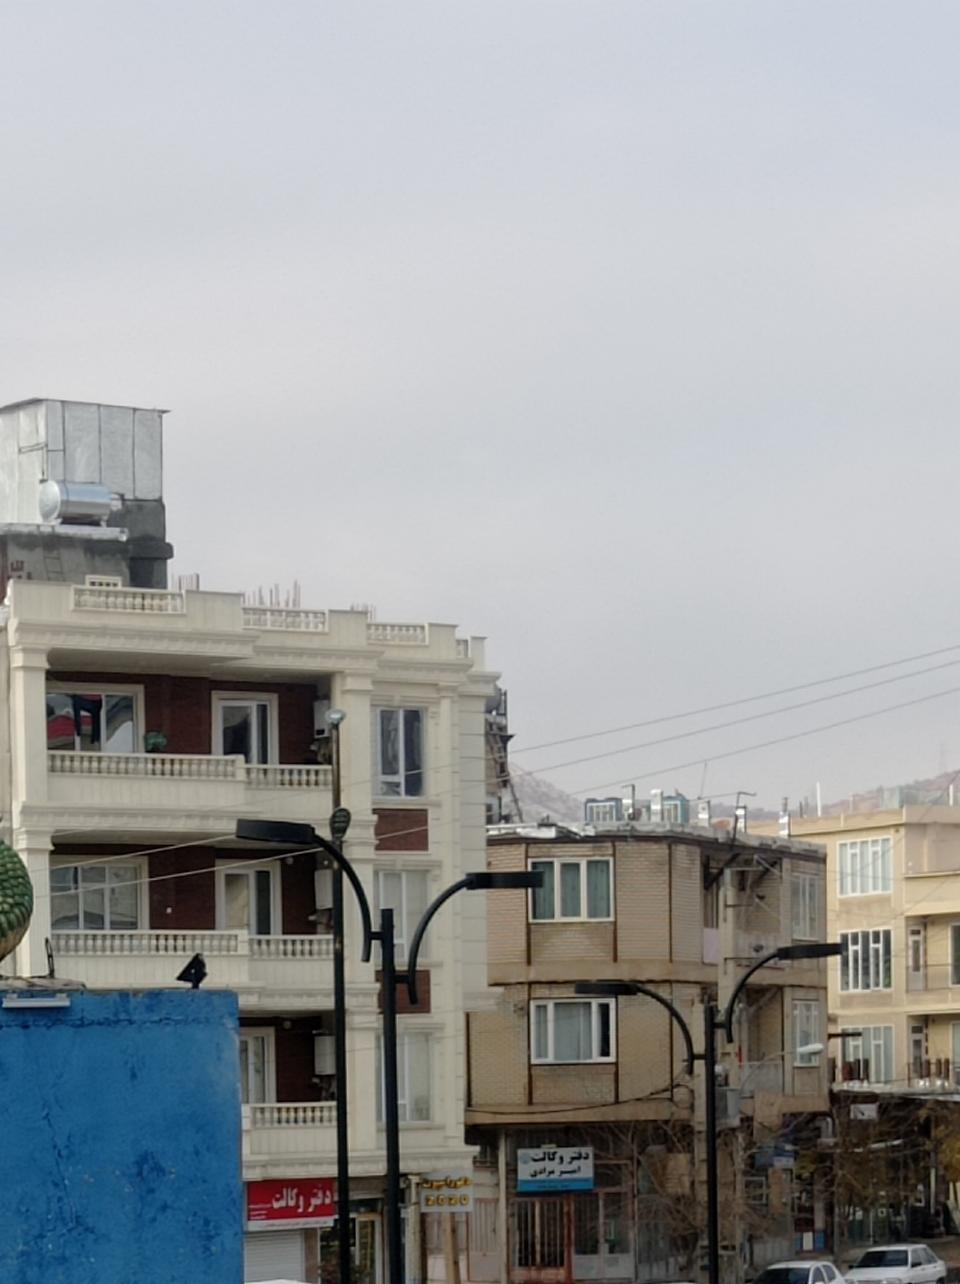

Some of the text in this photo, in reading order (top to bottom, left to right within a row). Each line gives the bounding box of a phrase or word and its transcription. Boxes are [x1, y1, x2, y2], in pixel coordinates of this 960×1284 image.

[530, 1148, 590, 1165] دفتر وکالت
[271, 1186, 305, 1213] وکالت
[307, 1184, 332, 1213] دفتر
